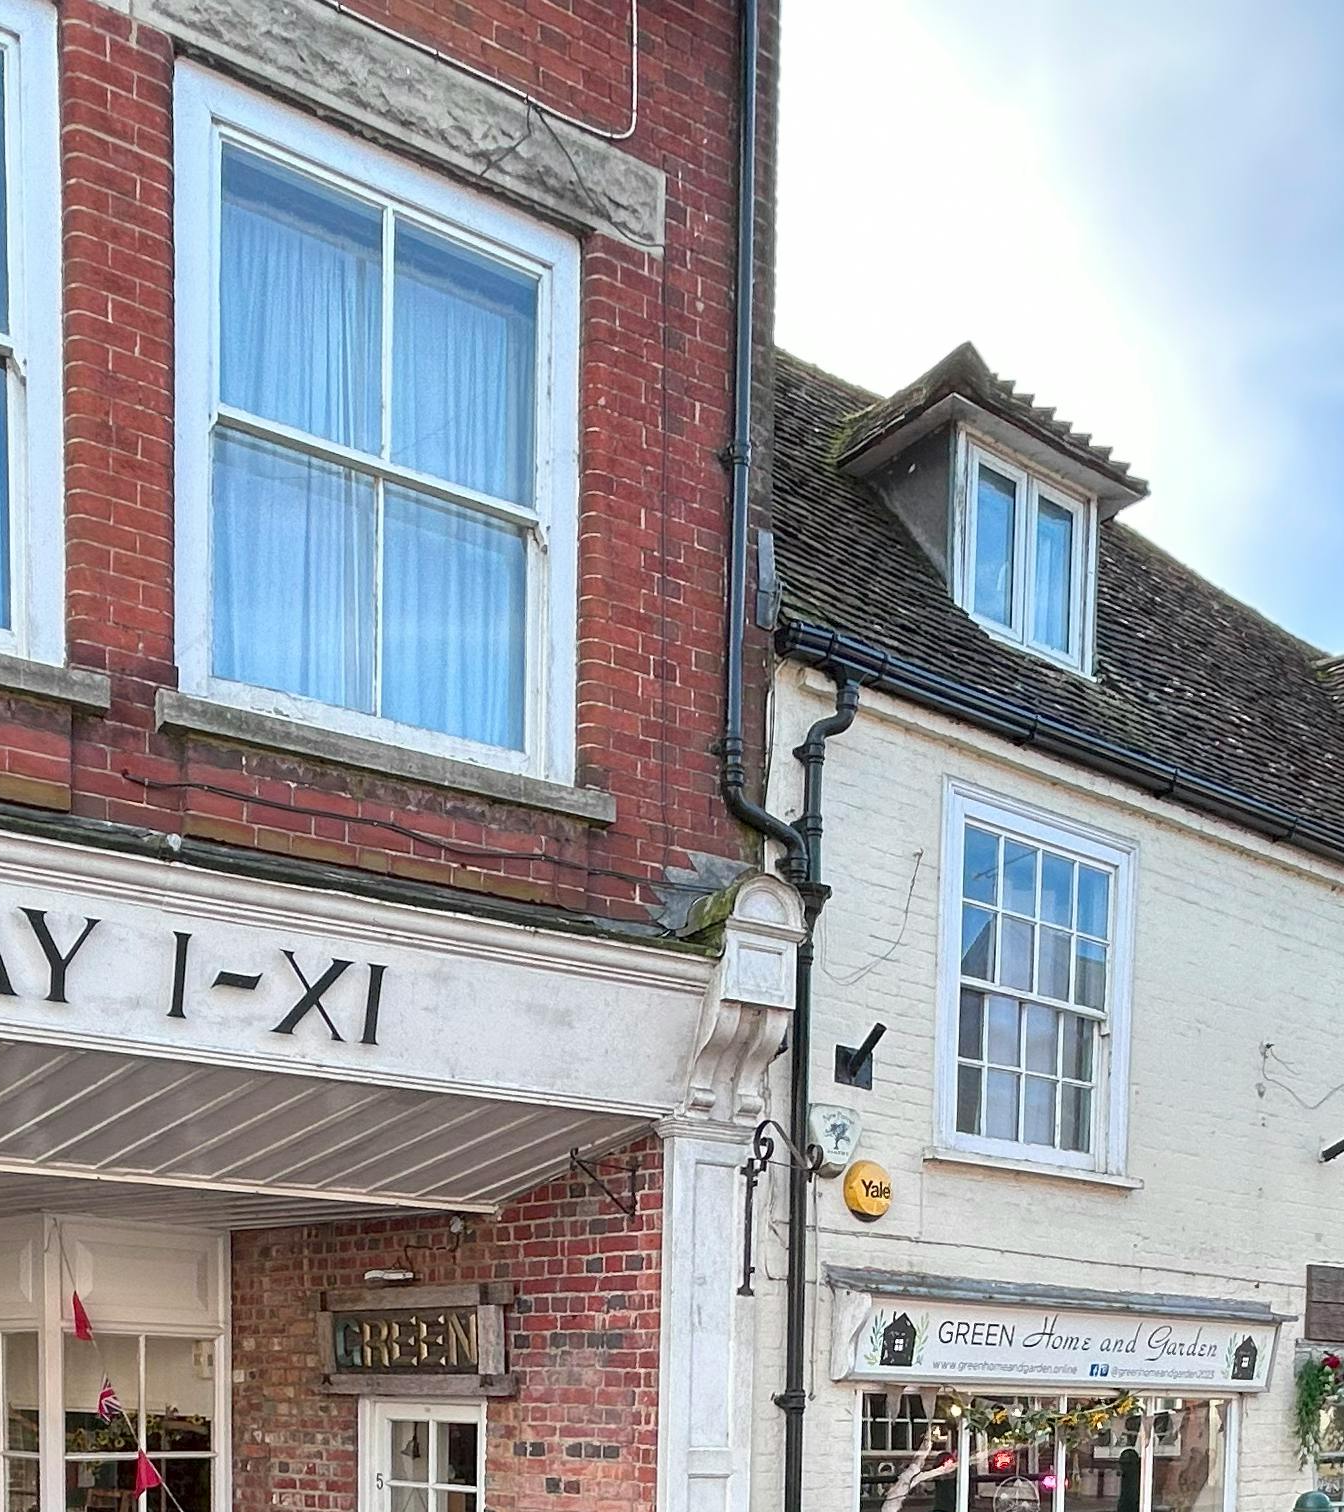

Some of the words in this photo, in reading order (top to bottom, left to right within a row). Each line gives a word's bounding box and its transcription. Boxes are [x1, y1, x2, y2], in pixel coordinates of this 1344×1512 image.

[167, 930, 389, 1046] I-XI
[860, 1179, 891, 1200] Yale
[335, 1313, 479, 1368] GREEN
[937, 1319, 1016, 1348] GREEN
[1022, 1315, 1092, 1352] Home
[1099, 1322, 1138, 1354] and
[1145, 1324, 1218, 1361] Garden
[376, 1472, 384, 1490] 5
